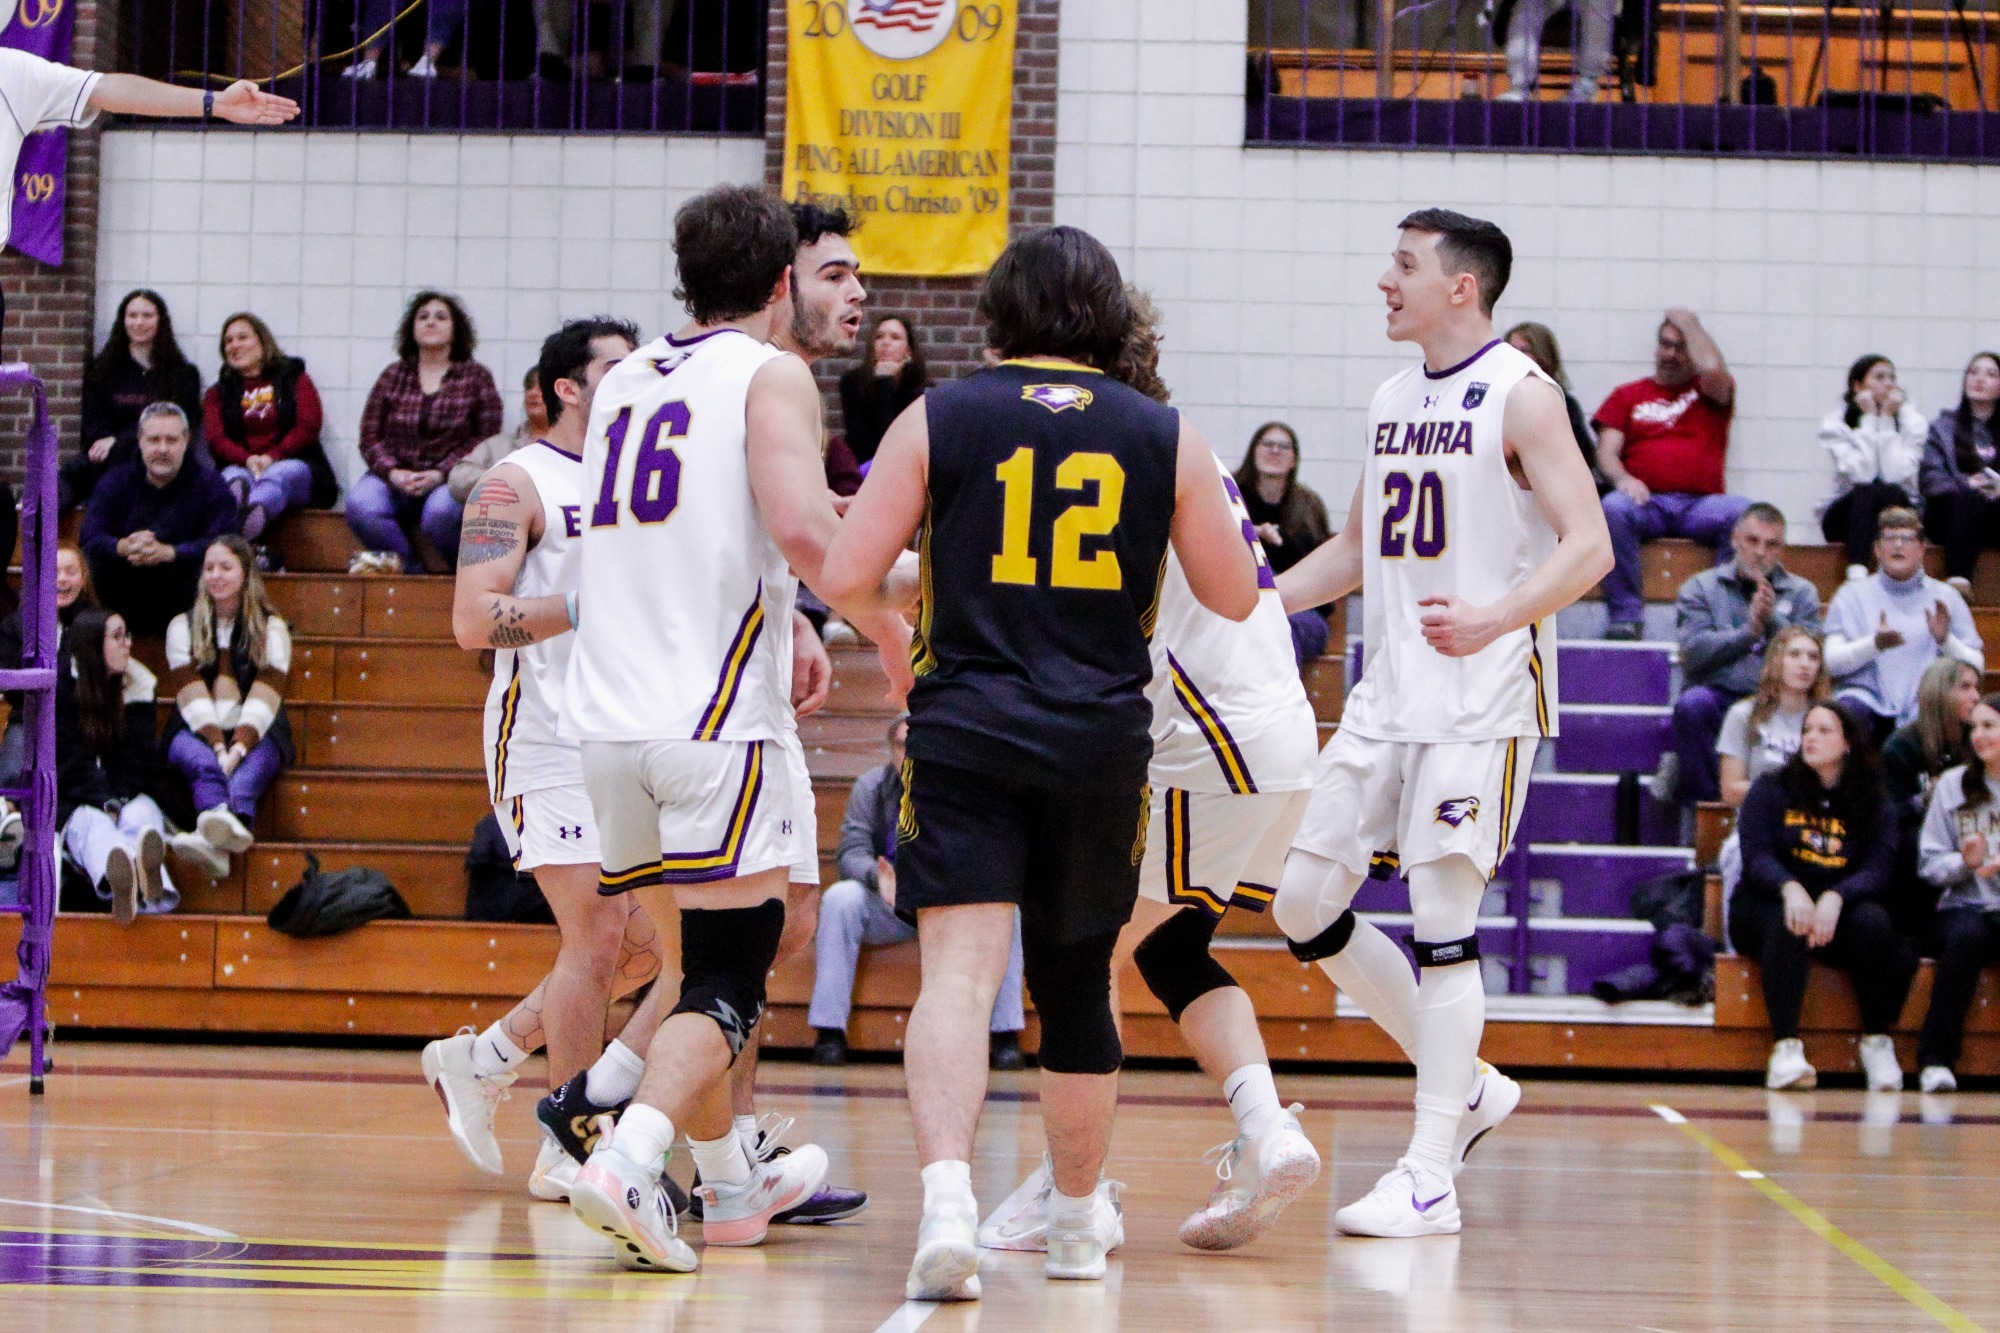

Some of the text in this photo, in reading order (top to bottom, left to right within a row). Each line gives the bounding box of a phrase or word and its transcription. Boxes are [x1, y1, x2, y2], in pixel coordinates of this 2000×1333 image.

[802, 0, 1002, 42] 20 09
[872, 73, 927, 101] GOLF
[838, 109, 962, 139] DIVISION III
[794, 144, 1000, 178] PING ALL-AMERICAN
[22, 172, 55, 203] '09
[885, 185, 963, 214] Christo
[968, 186, 1000, 214] '09
[1374, 420, 1474, 456] ELMIRA
[590, 397, 694, 530] 16
[992, 446, 1126, 591] 12
[1380, 468, 1449, 560] 20
